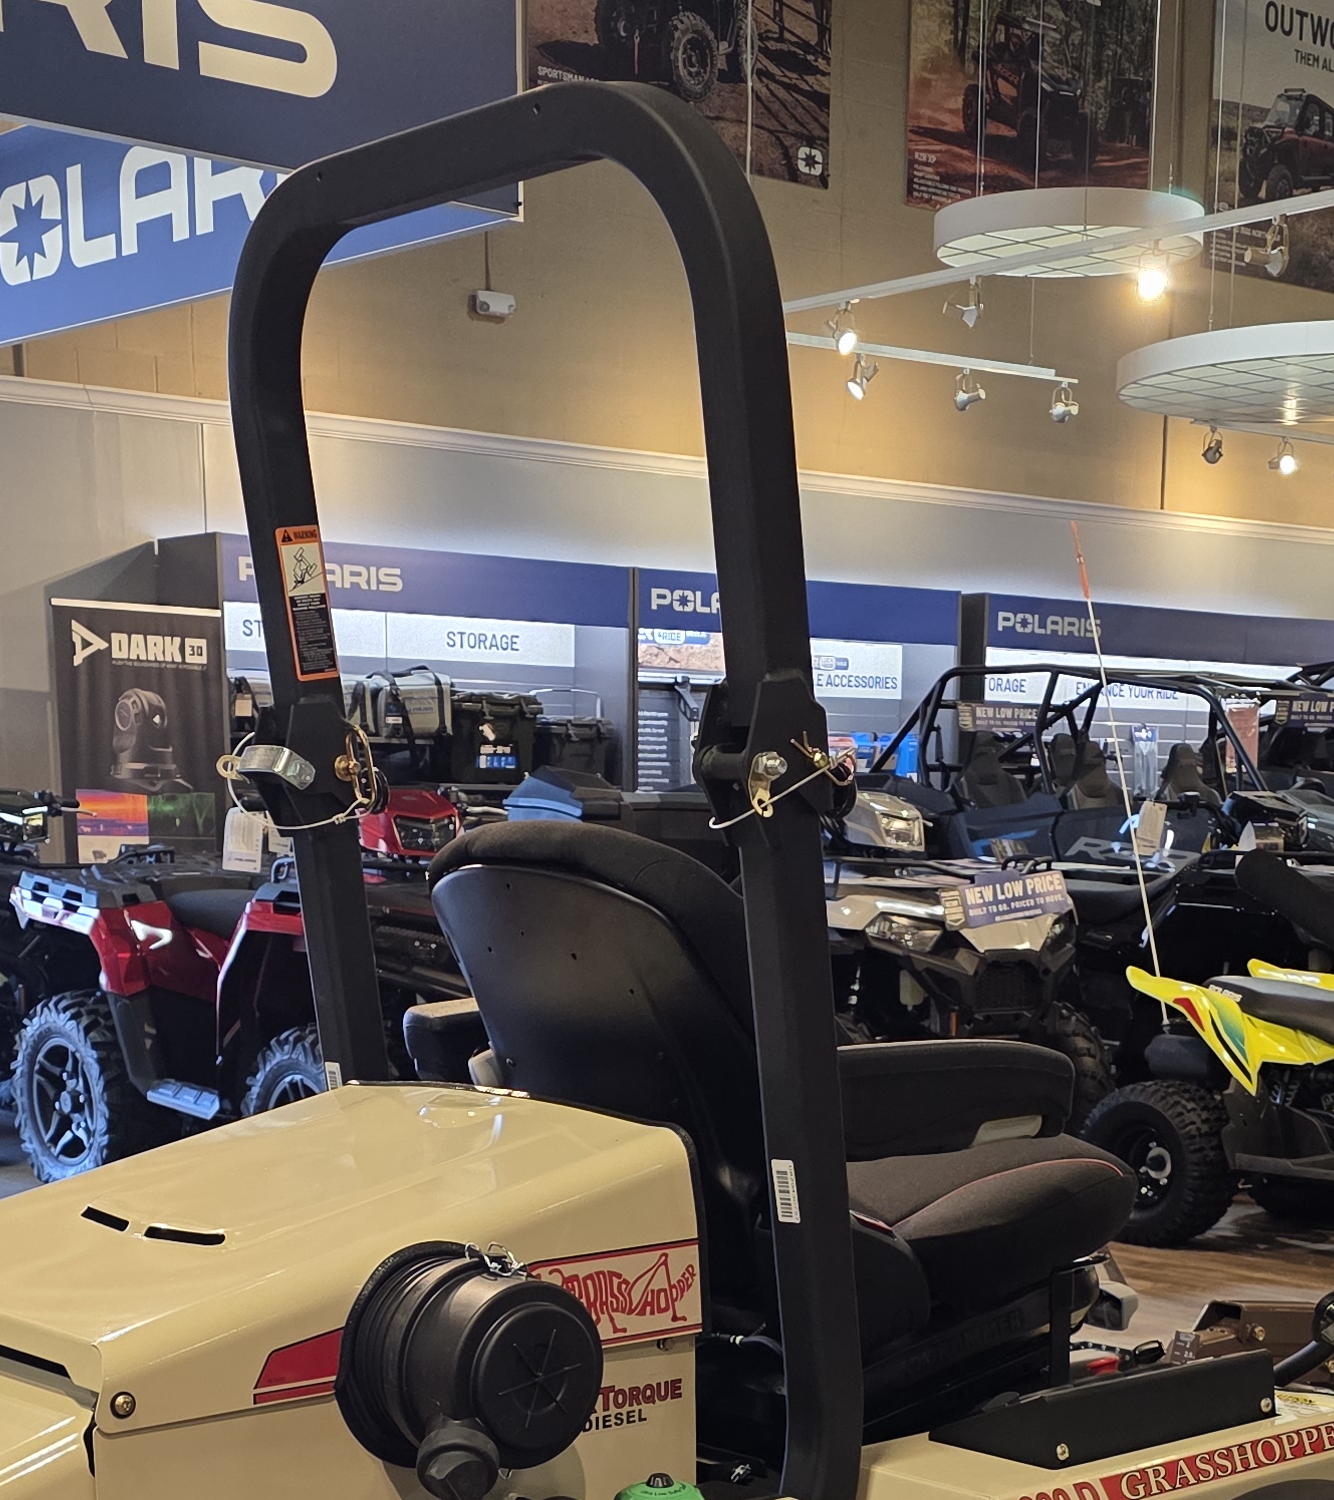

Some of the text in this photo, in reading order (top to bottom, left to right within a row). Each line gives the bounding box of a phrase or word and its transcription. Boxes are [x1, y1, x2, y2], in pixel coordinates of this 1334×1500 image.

[1294, 49, 1319, 69] THEM
[238, 556, 403, 592] PARIS
[997, 611, 1101, 638] POLARIS
[110, 632, 183, 663] DARK
[446, 631, 520, 652] STORAGE
[825, 674, 898, 689] ACCESSORIES
[987, 677, 1027, 694] ORAGE
[975, 706, 994, 718] NEW
[995, 707, 1013, 719] LOW
[1014, 708, 1038, 720] PRICE
[1291, 700, 1310, 712] NEW
[1310, 701, 1329, 713] LOW
[965, 874, 1063, 905] NEW LOW PRICE
[582, 1408, 648, 1433] DIESEL
